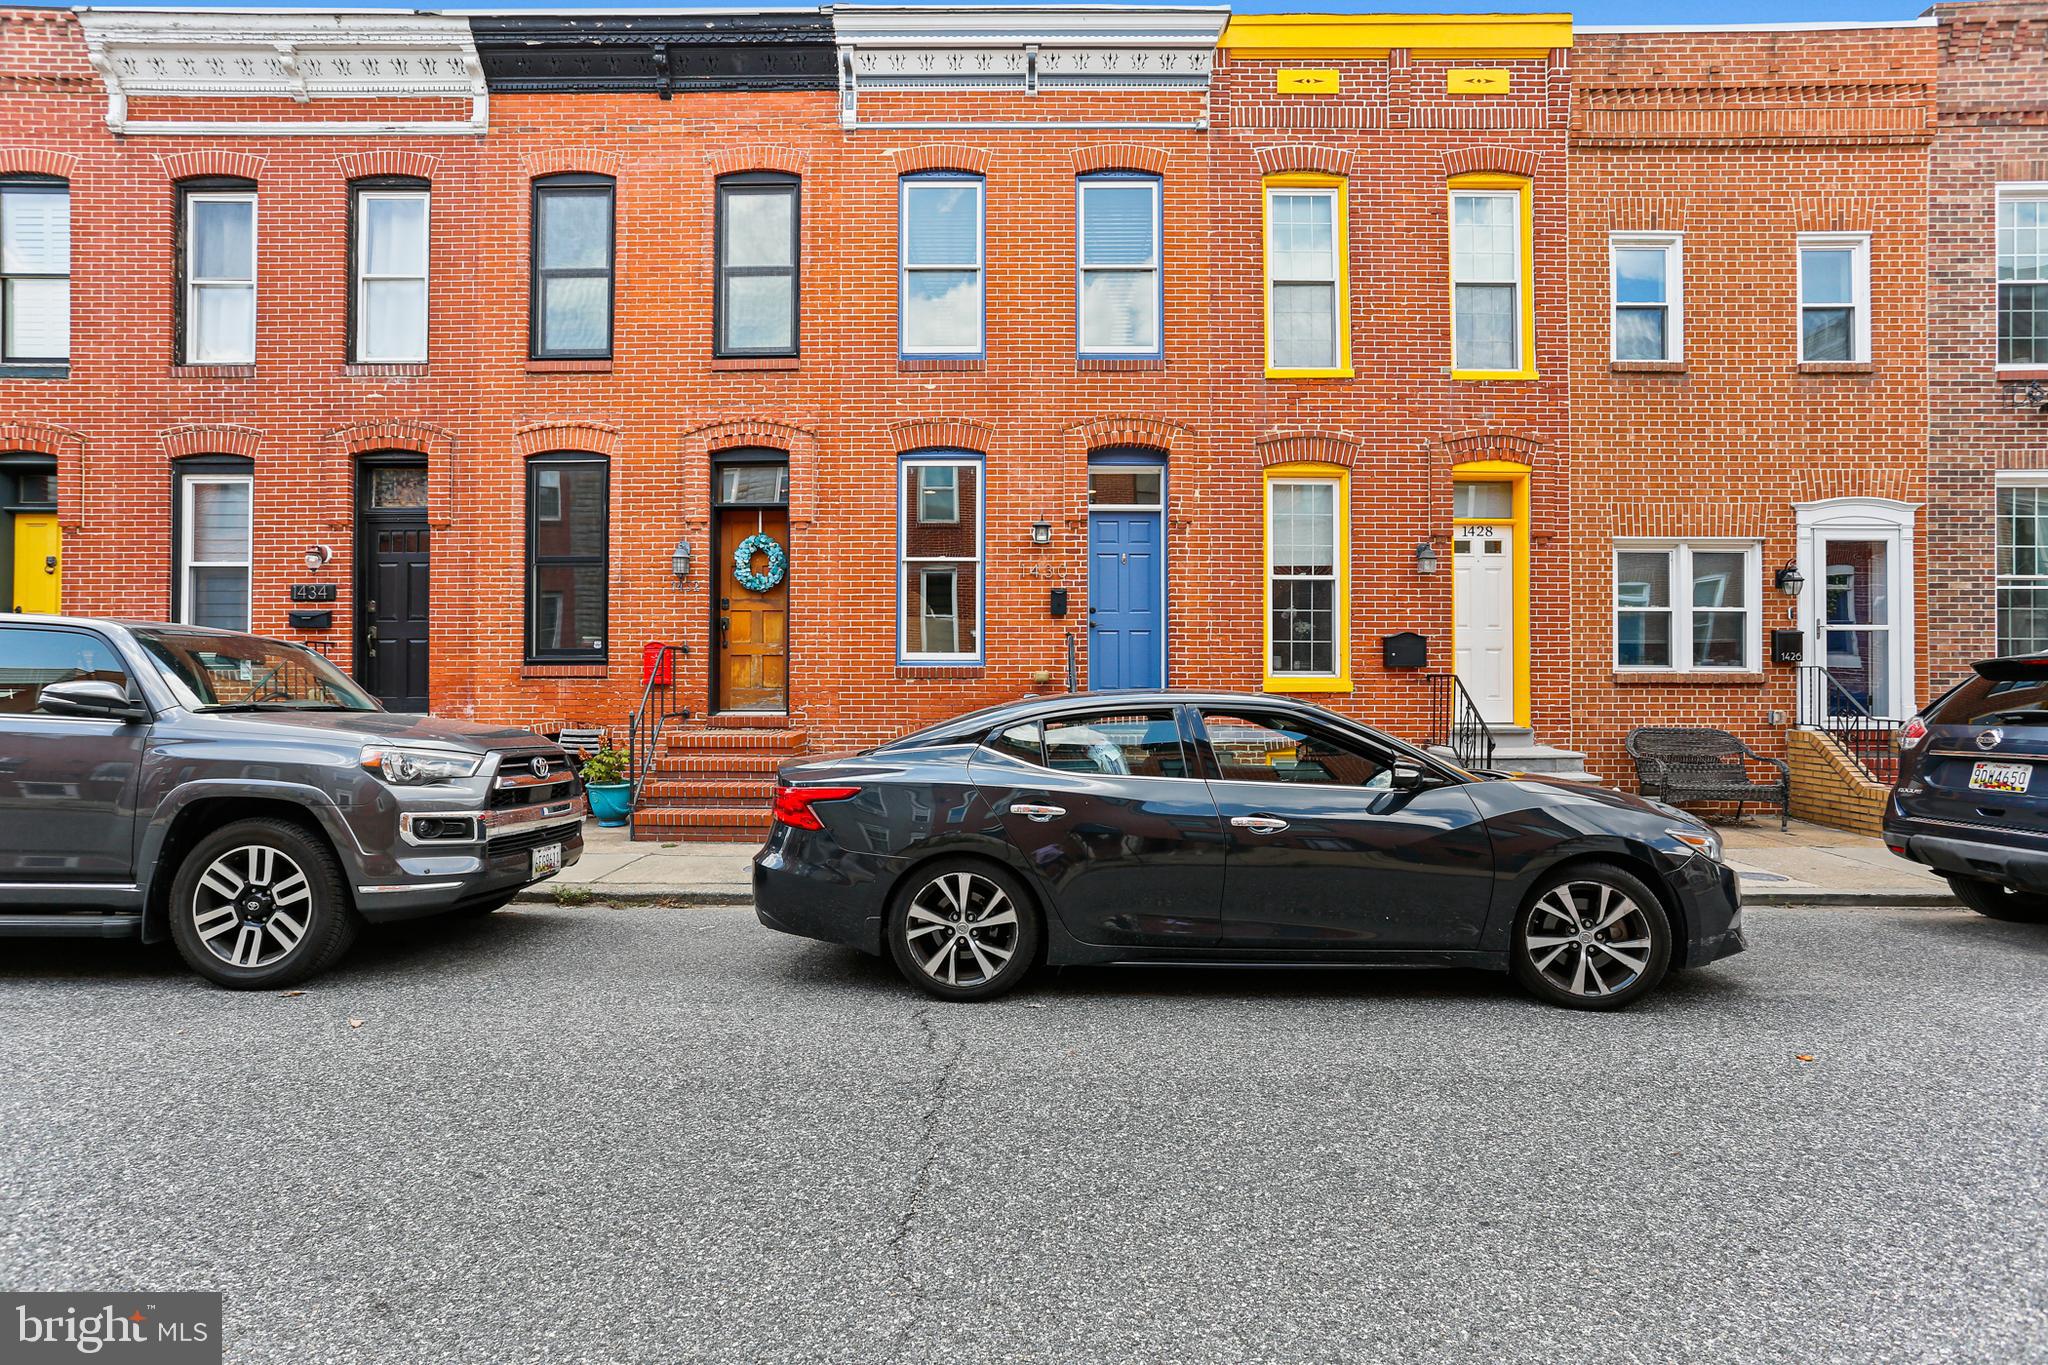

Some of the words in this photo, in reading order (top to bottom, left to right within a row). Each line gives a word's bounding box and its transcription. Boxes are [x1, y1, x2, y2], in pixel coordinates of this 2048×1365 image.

[1462, 525, 1493, 537] 1428
[1022, 564, 1067, 578] 1430
[293, 584, 328, 600] 1434
[1781, 652, 1802, 661] 1426
